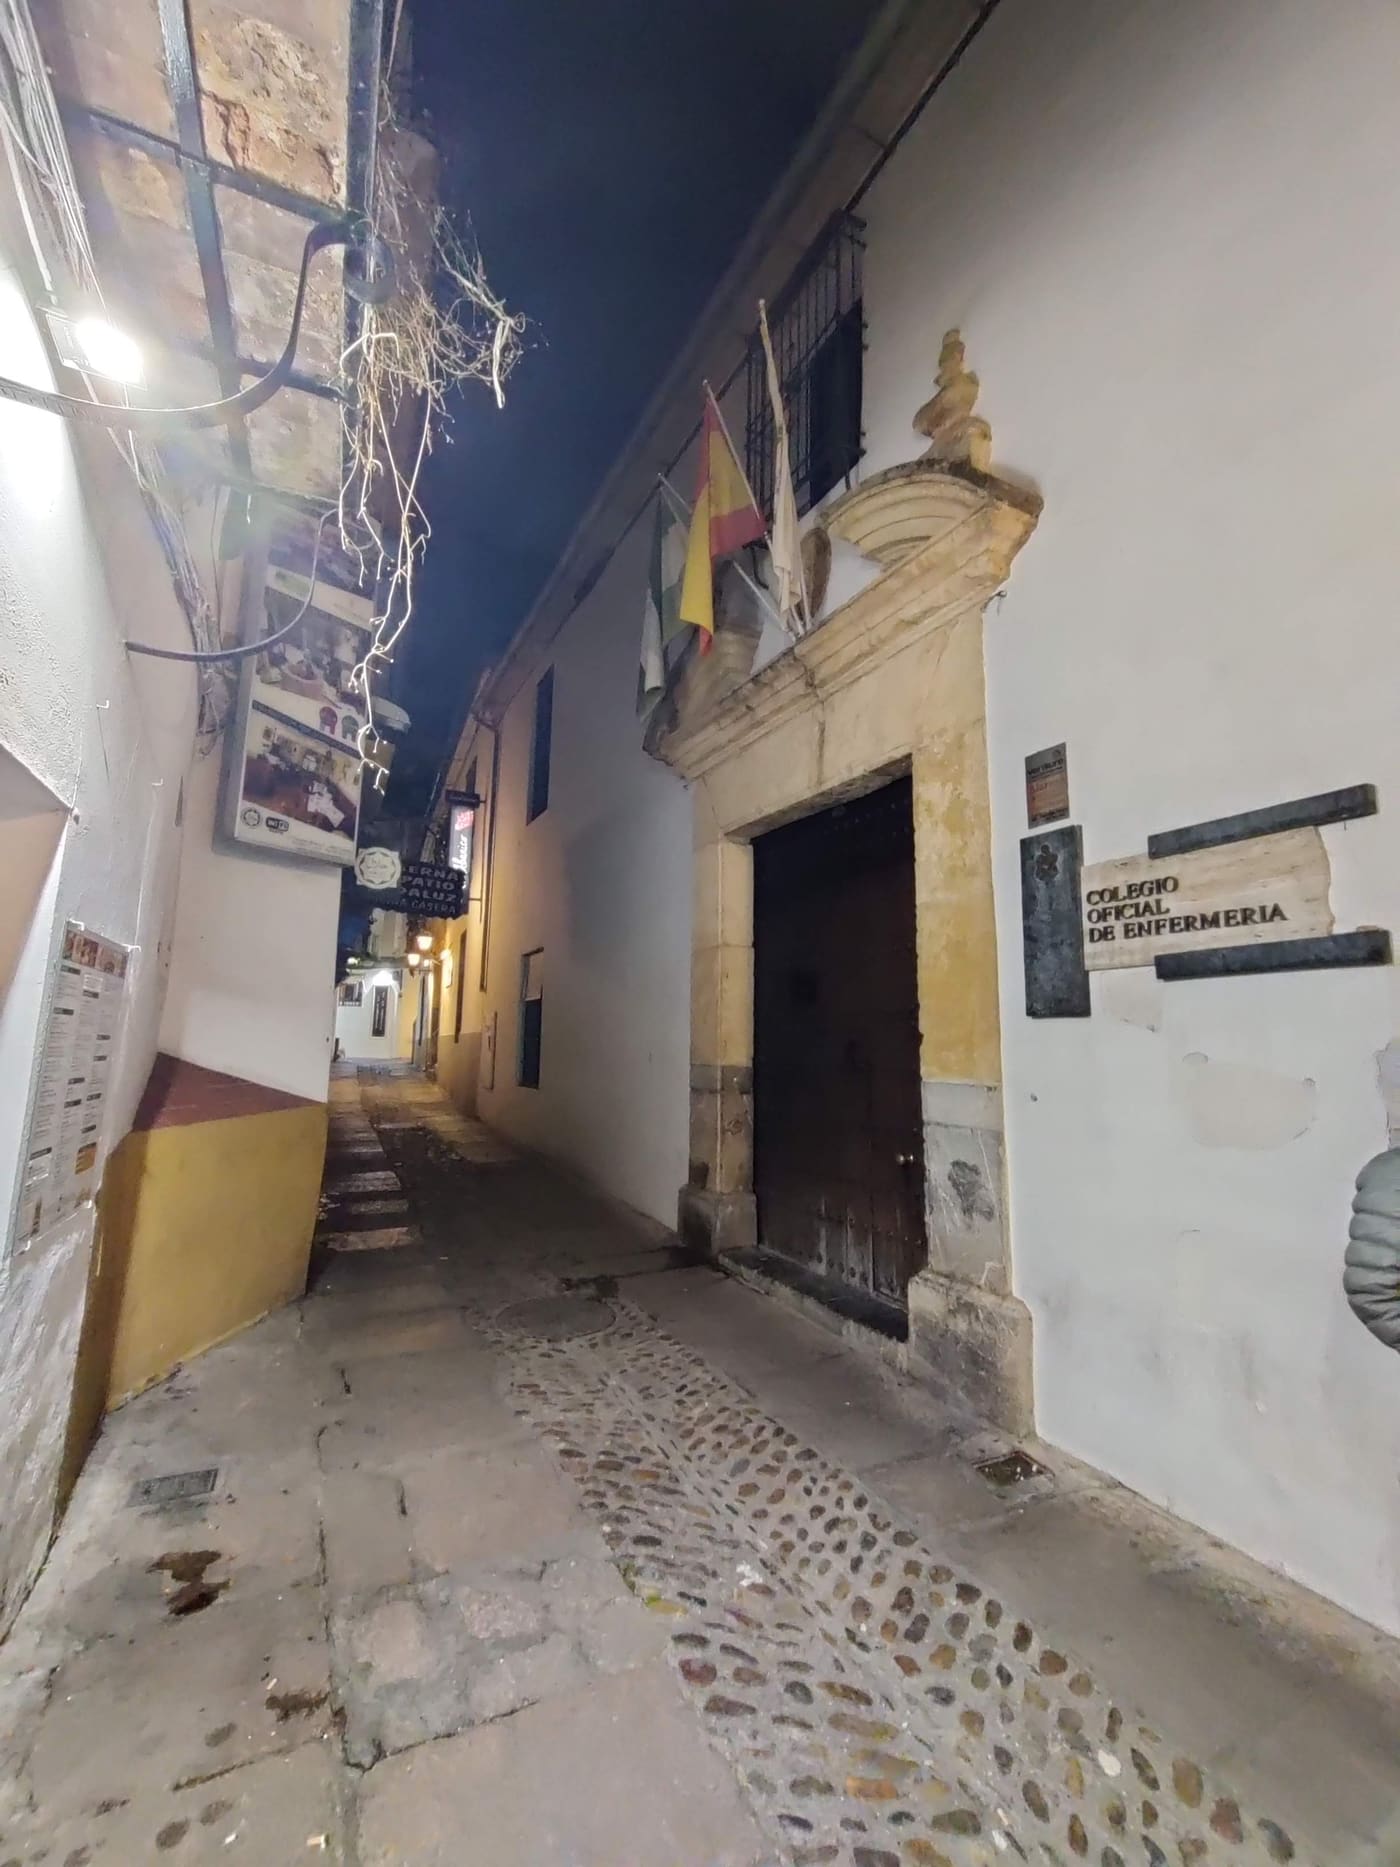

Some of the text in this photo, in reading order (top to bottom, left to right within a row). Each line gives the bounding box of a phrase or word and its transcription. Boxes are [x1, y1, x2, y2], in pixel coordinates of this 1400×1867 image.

[403, 864, 458, 881] ERNA
[1086, 876, 1179, 905] COLEGIO
[1087, 899, 1170, 924] OFICIAL
[1089, 902, 1288, 943] DE ENFERMERIA
